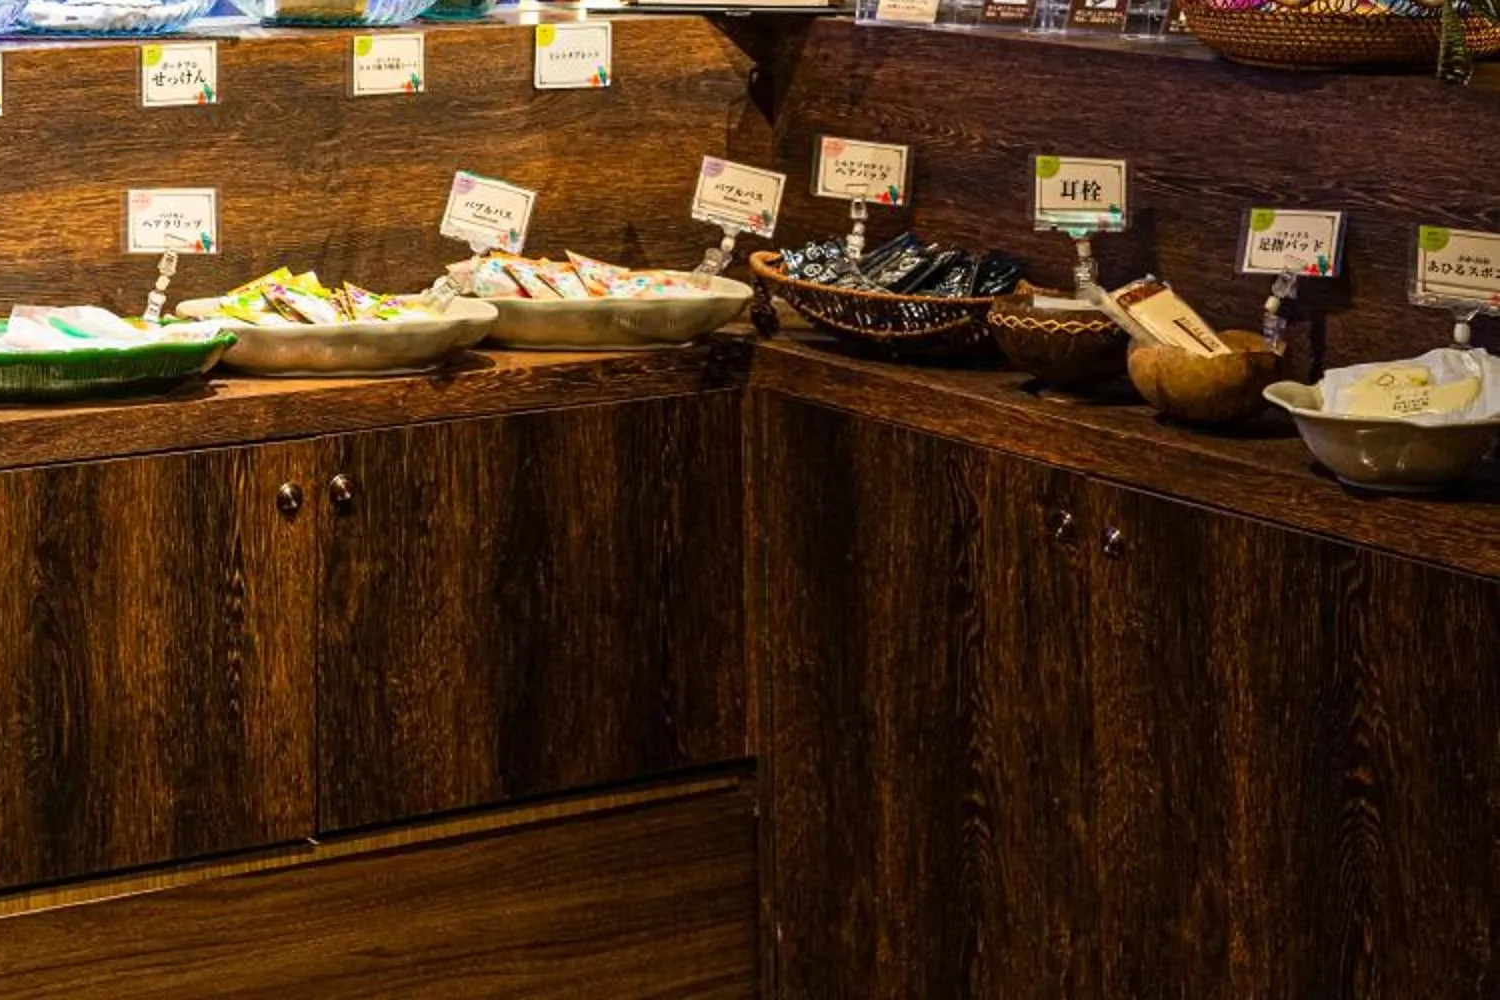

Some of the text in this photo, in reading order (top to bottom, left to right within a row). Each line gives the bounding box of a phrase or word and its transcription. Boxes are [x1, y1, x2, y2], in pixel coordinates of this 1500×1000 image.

[152, 69, 205, 87] せっけん
[1060, 179, 1102, 202] 耳栓
[1259, 237, 1325, 253] 足指パッド
